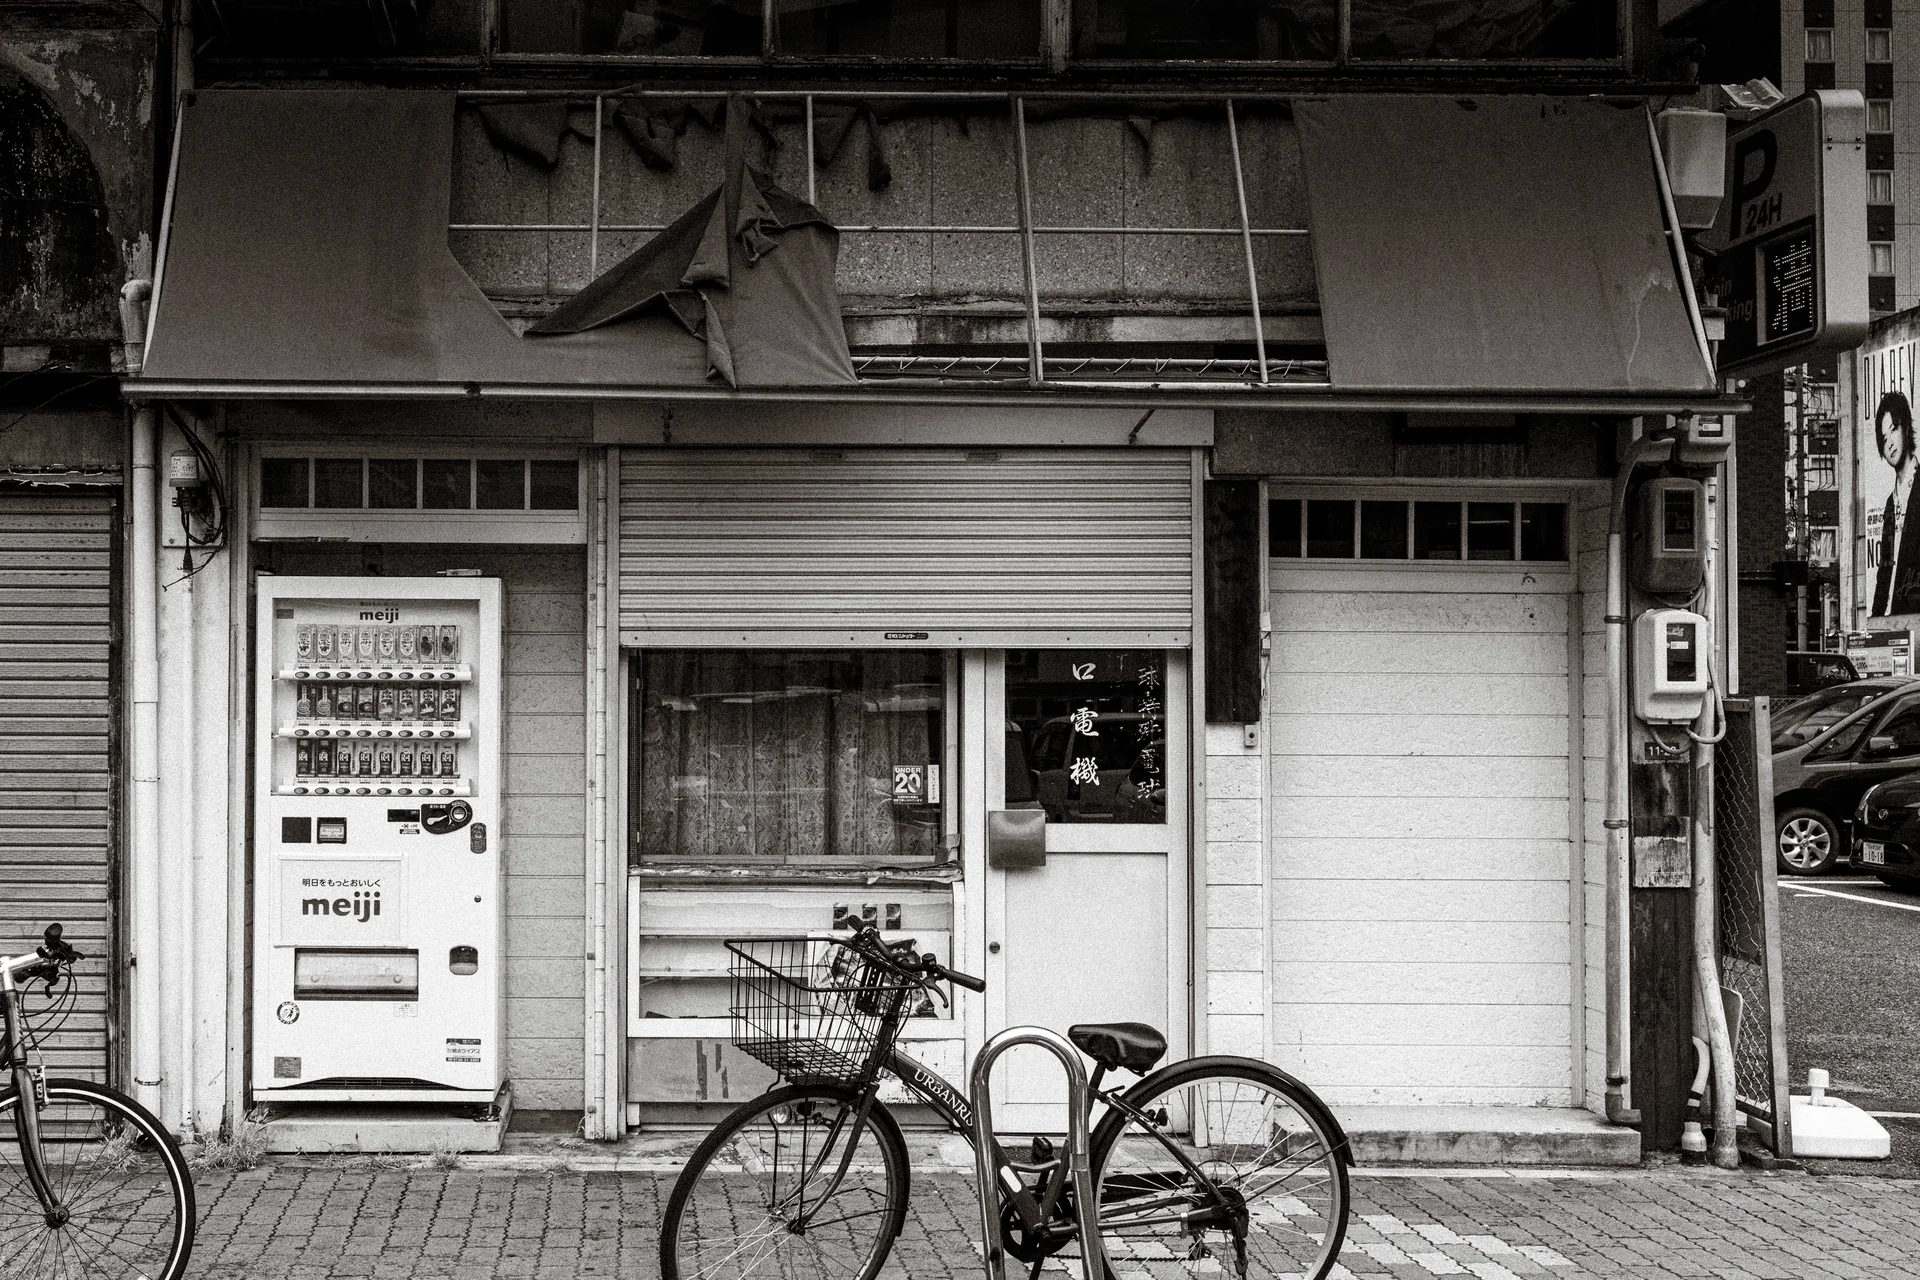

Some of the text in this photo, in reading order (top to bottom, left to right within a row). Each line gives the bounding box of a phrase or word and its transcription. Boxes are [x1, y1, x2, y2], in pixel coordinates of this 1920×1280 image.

[1730, 129, 1778, 241] P
[1745, 193, 1783, 235] 24H
[1771, 240, 1812, 332] 満
[359, 608, 399, 624] meiji
[895, 773, 921, 793] 20
[302, 878, 381, 888] 明日をもっとおいしく
[302, 891, 381, 923] meiji
